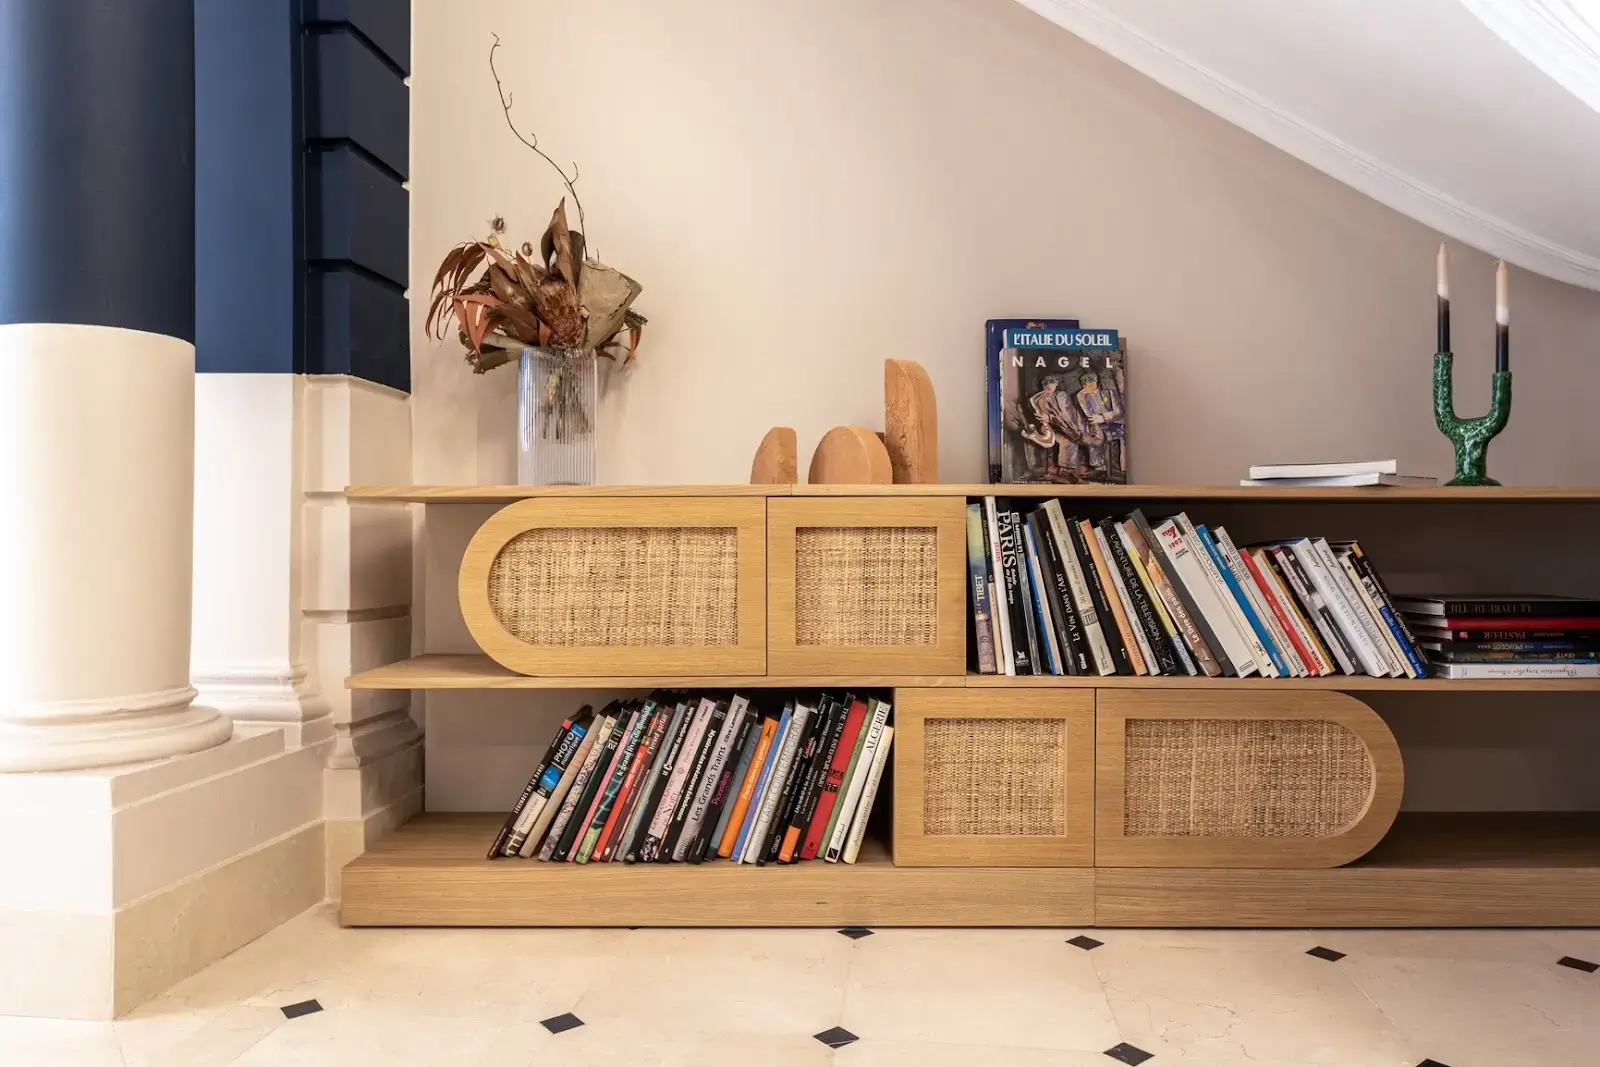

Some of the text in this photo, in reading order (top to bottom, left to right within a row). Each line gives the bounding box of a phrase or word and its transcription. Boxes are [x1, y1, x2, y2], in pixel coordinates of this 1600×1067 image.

[1013, 333, 1112, 346] L'ITALIE DU SOLEIL
[1012, 356, 1113, 368] NAGEL
[997, 510, 1017, 568] PARIS
[1110, 533, 1133, 577] L'AVENTURE
[975, 574, 985, 602] TIBET
[1129, 577, 1138, 588] DE
[1134, 588, 1143, 601] LA
[1138, 599, 1161, 640] TÉLÉVISION
[1165, 586, 1199, 642] Le livre des pains
[1473, 604, 1485, 613] DU
[1488, 604, 1516, 613] LIVRE
[1392, 611, 1416, 644] Compostelle
[1484, 631, 1526, 640] PASTEUR
[1492, 642, 1523, 650] PEUGEOT
[723, 703, 743, 742] Clive Lamming
[553, 731, 575, 762] PHOTO
[619, 752, 632, 770] grand
[627, 737, 637, 752] livre
[701, 728, 716, 754] Mystères
[533, 763, 545, 778] DANSE
[698, 754, 706, 764] des
[760, 796, 776, 824] L'ART
[770, 712, 804, 795] CONTEMPORAIN
[691, 745, 726, 821] Les Grands Trains
